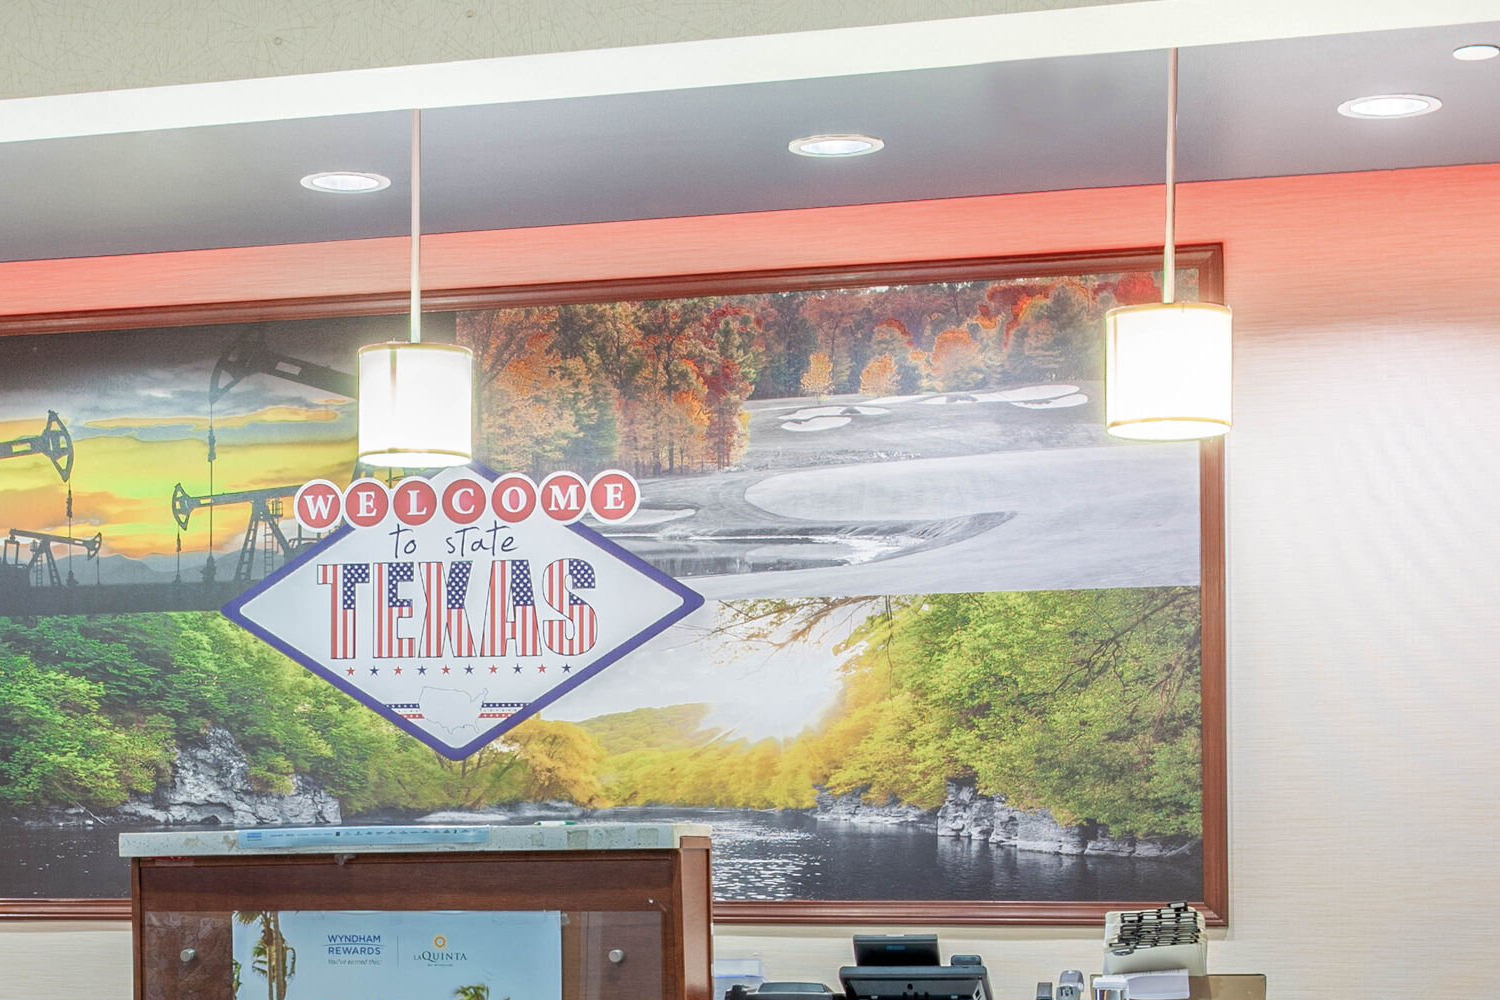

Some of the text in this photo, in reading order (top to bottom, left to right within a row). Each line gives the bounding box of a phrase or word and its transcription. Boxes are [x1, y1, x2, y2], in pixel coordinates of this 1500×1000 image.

[301, 481, 628, 522] WELCOME
[389, 520, 520, 559] to state
[316, 558, 598, 659] TEXAS
[328, 934, 380, 943] WYNDHAM
[328, 946, 380, 955] REWARDS
